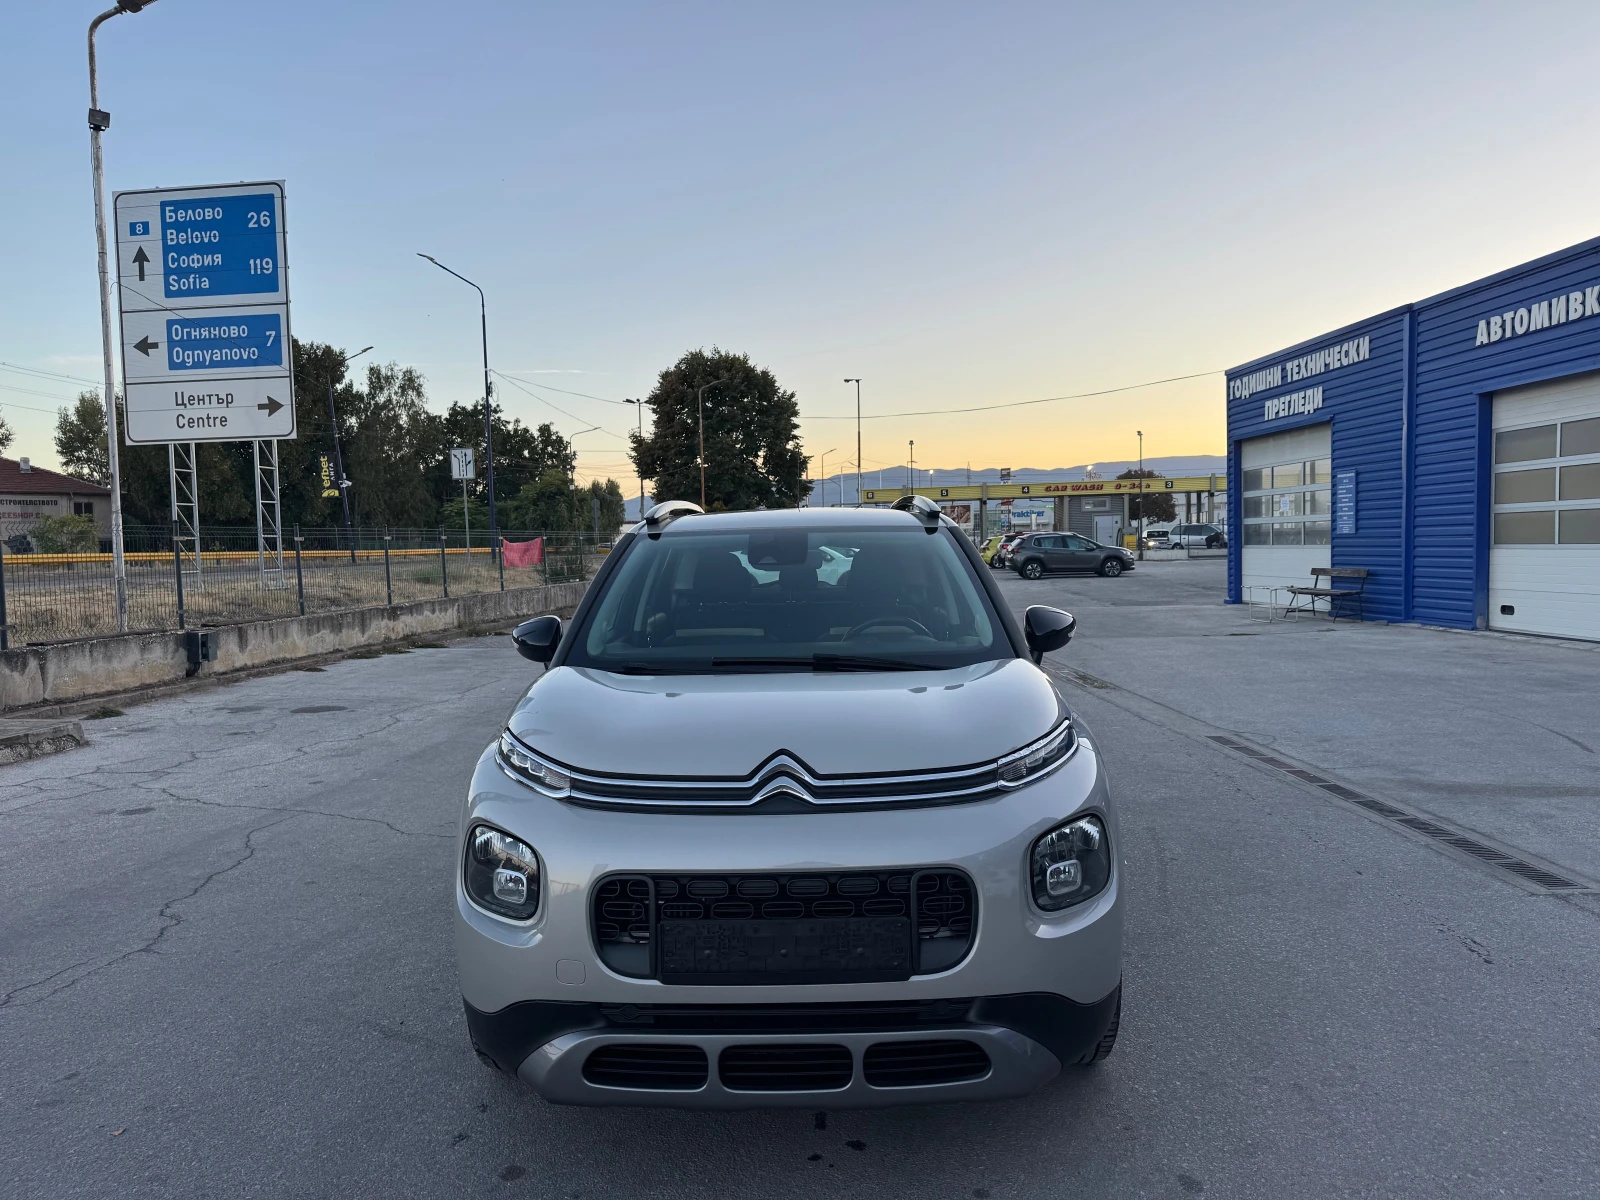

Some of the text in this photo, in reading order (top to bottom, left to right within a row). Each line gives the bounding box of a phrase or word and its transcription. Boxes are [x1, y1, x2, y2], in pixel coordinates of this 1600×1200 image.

[166, 207, 223, 222] Белово
[248, 212, 270, 228] 26
[136, 224, 144, 234] 8
[166, 228, 219, 245] Belovo
[168, 252, 222, 269] София
[249, 258, 272, 275] 119
[169, 275, 209, 290] Sofia
[1476, 285, 1600, 346] АВТОМИВК
[172, 324, 248, 340] Огняново
[265, 331, 276, 347] 7
[173, 346, 258, 366] Ognyanovo
[1229, 336, 1370, 400] ГОДИШНИ ТЕХНИЧЕСКИ
[174, 391, 234, 409] Център
[1265, 386, 1322, 420] ПРЕГЛЕДИ
[176, 414, 228, 429] Centre
[320, 456, 330, 487] efbet
